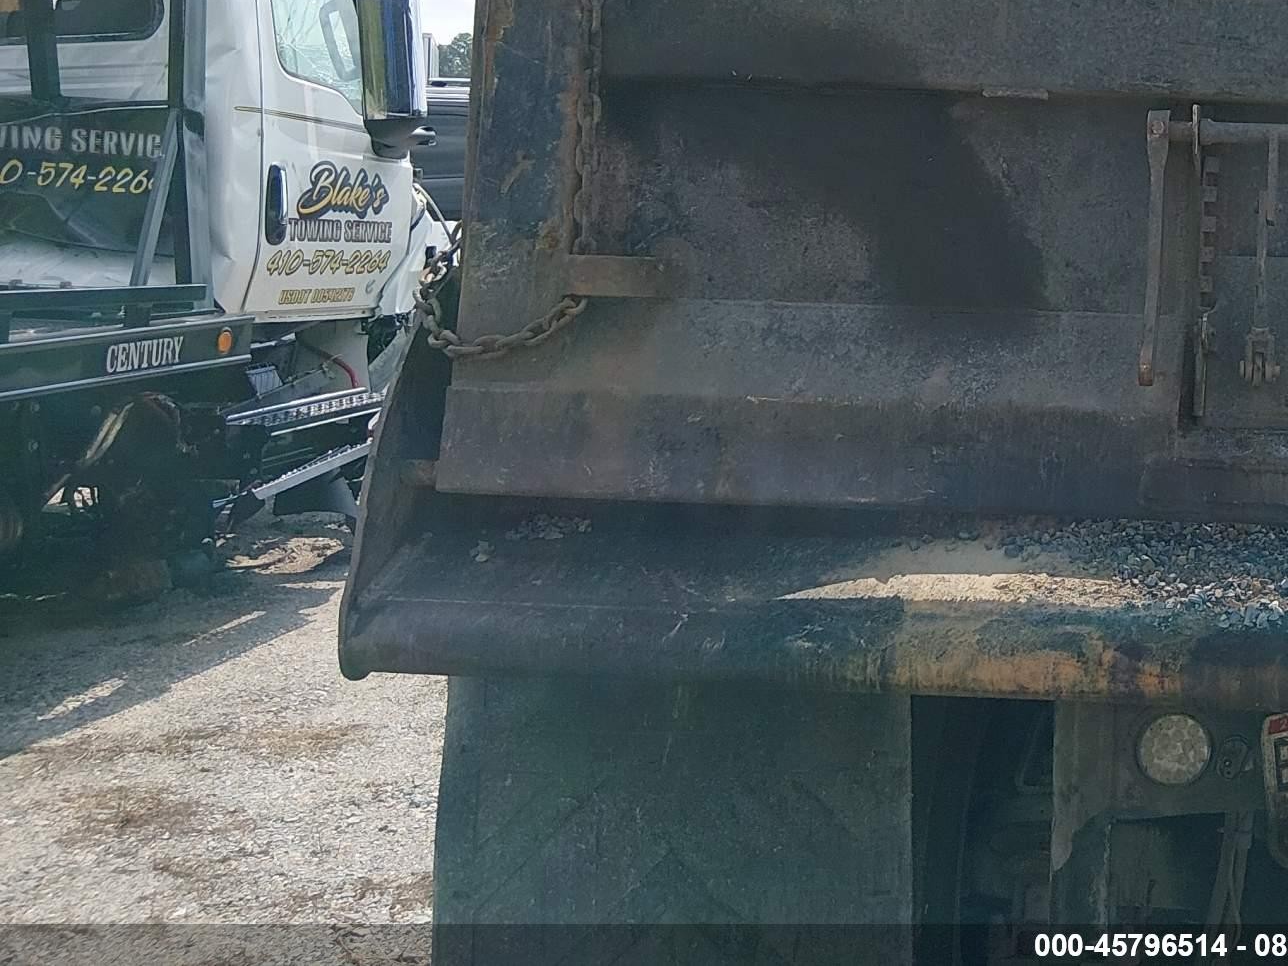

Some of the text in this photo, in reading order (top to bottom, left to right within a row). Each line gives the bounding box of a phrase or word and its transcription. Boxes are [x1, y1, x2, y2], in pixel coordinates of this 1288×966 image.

[71, 128, 165, 160] SERVIC
[0, 158, 154, 194] 0-574-226
[298, 161, 388, 217] Blake's
[288, 218, 393, 244] TOWING SERVICE
[266, 248, 391, 276] 410-574-2264
[106, 336, 184, 373] CENTURY
